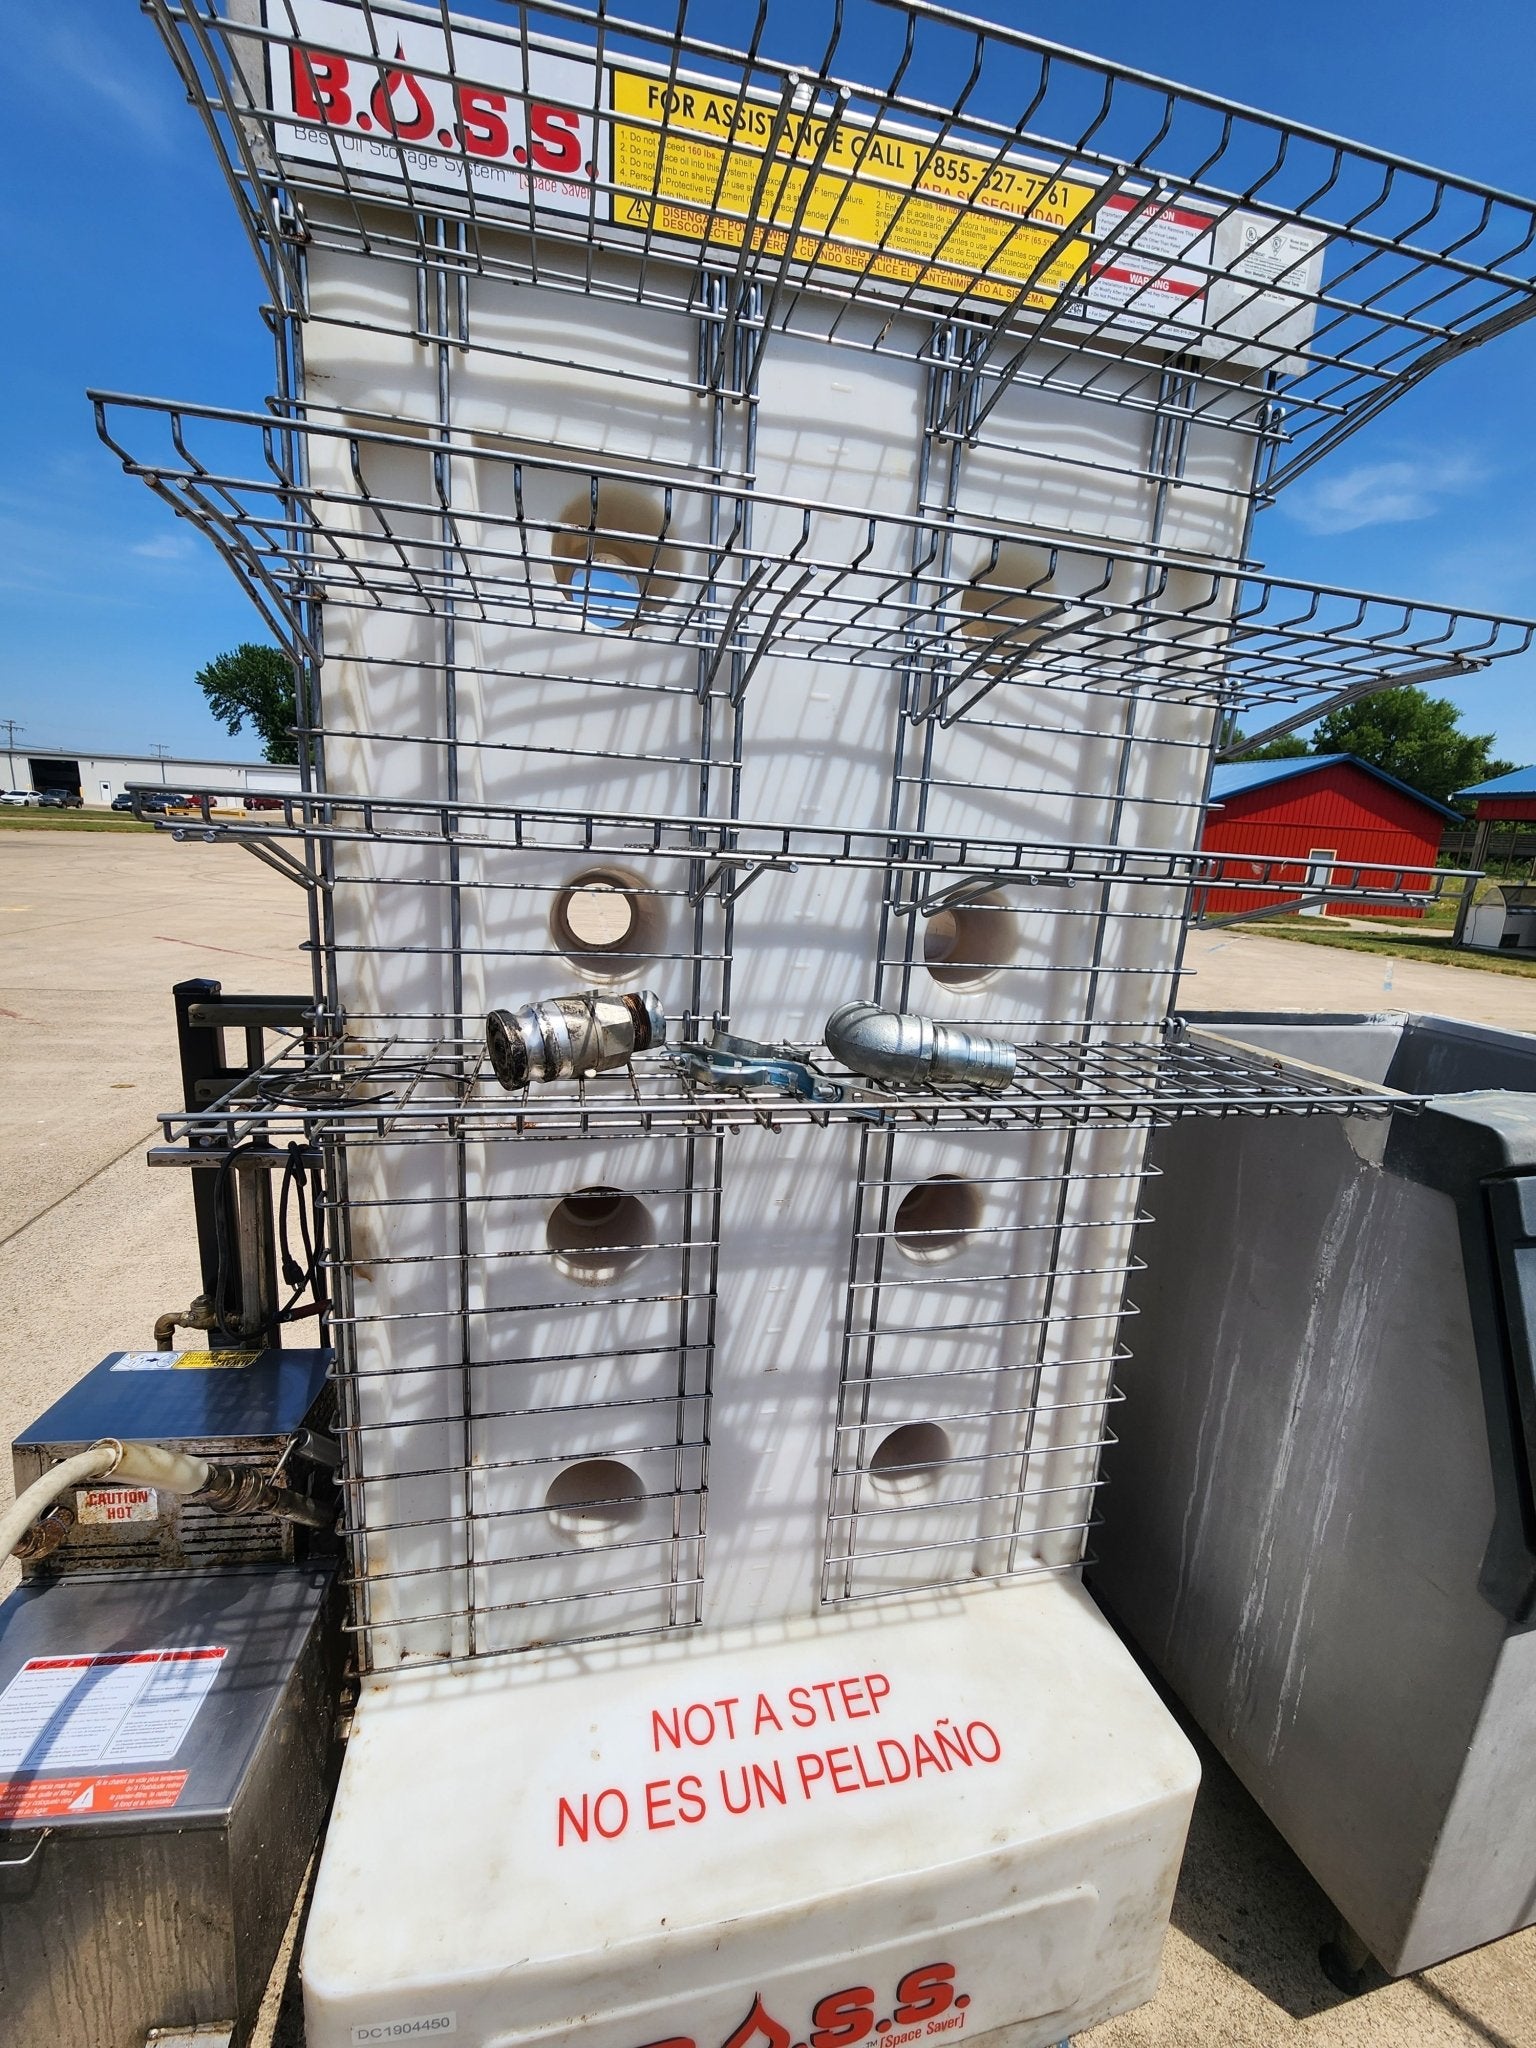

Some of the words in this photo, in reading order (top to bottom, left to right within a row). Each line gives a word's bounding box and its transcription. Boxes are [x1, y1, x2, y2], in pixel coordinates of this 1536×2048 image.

[294, 126, 331, 146] Bes
[648, 85, 695, 119] FOR
[851, 136, 905, 169] CALL
[630, 131, 641, 142] Do
[643, 136, 656, 146] not
[689, 146, 702, 156] 160
[704, 148, 718, 161] lbs.
[630, 144, 641, 155] Do
[643, 149, 656, 159] not
[726, 168, 748, 179] ystem
[630, 157, 641, 168] Do
[691, 171, 717, 184] shelve
[732, 181, 745, 190] use
[666, 177, 703, 193] Protective
[801, 246, 841, 262] CUNDO
[901, 266, 912, 278] EL
[992, 285, 1003, 297] AL
[1006, 289, 1047, 306] SISEMA.
[1130, 274, 1170, 291] WARING
[88, 1491, 148, 1506] CAUTION
[107, 1506, 132, 1519] HOT
[652, 1697, 739, 1752] NOT
[754, 1693, 784, 1735] A
[788, 1673, 891, 1727] STEP
[557, 1787, 628, 1846] NO
[645, 1774, 706, 1831] ES
[720, 1760, 787, 1814] UN
[796, 1718, 1002, 1800] PELDAÑO
[357, 2016, 450, 2040] DC1904450
[926, 2012, 965, 2036] Saver]
